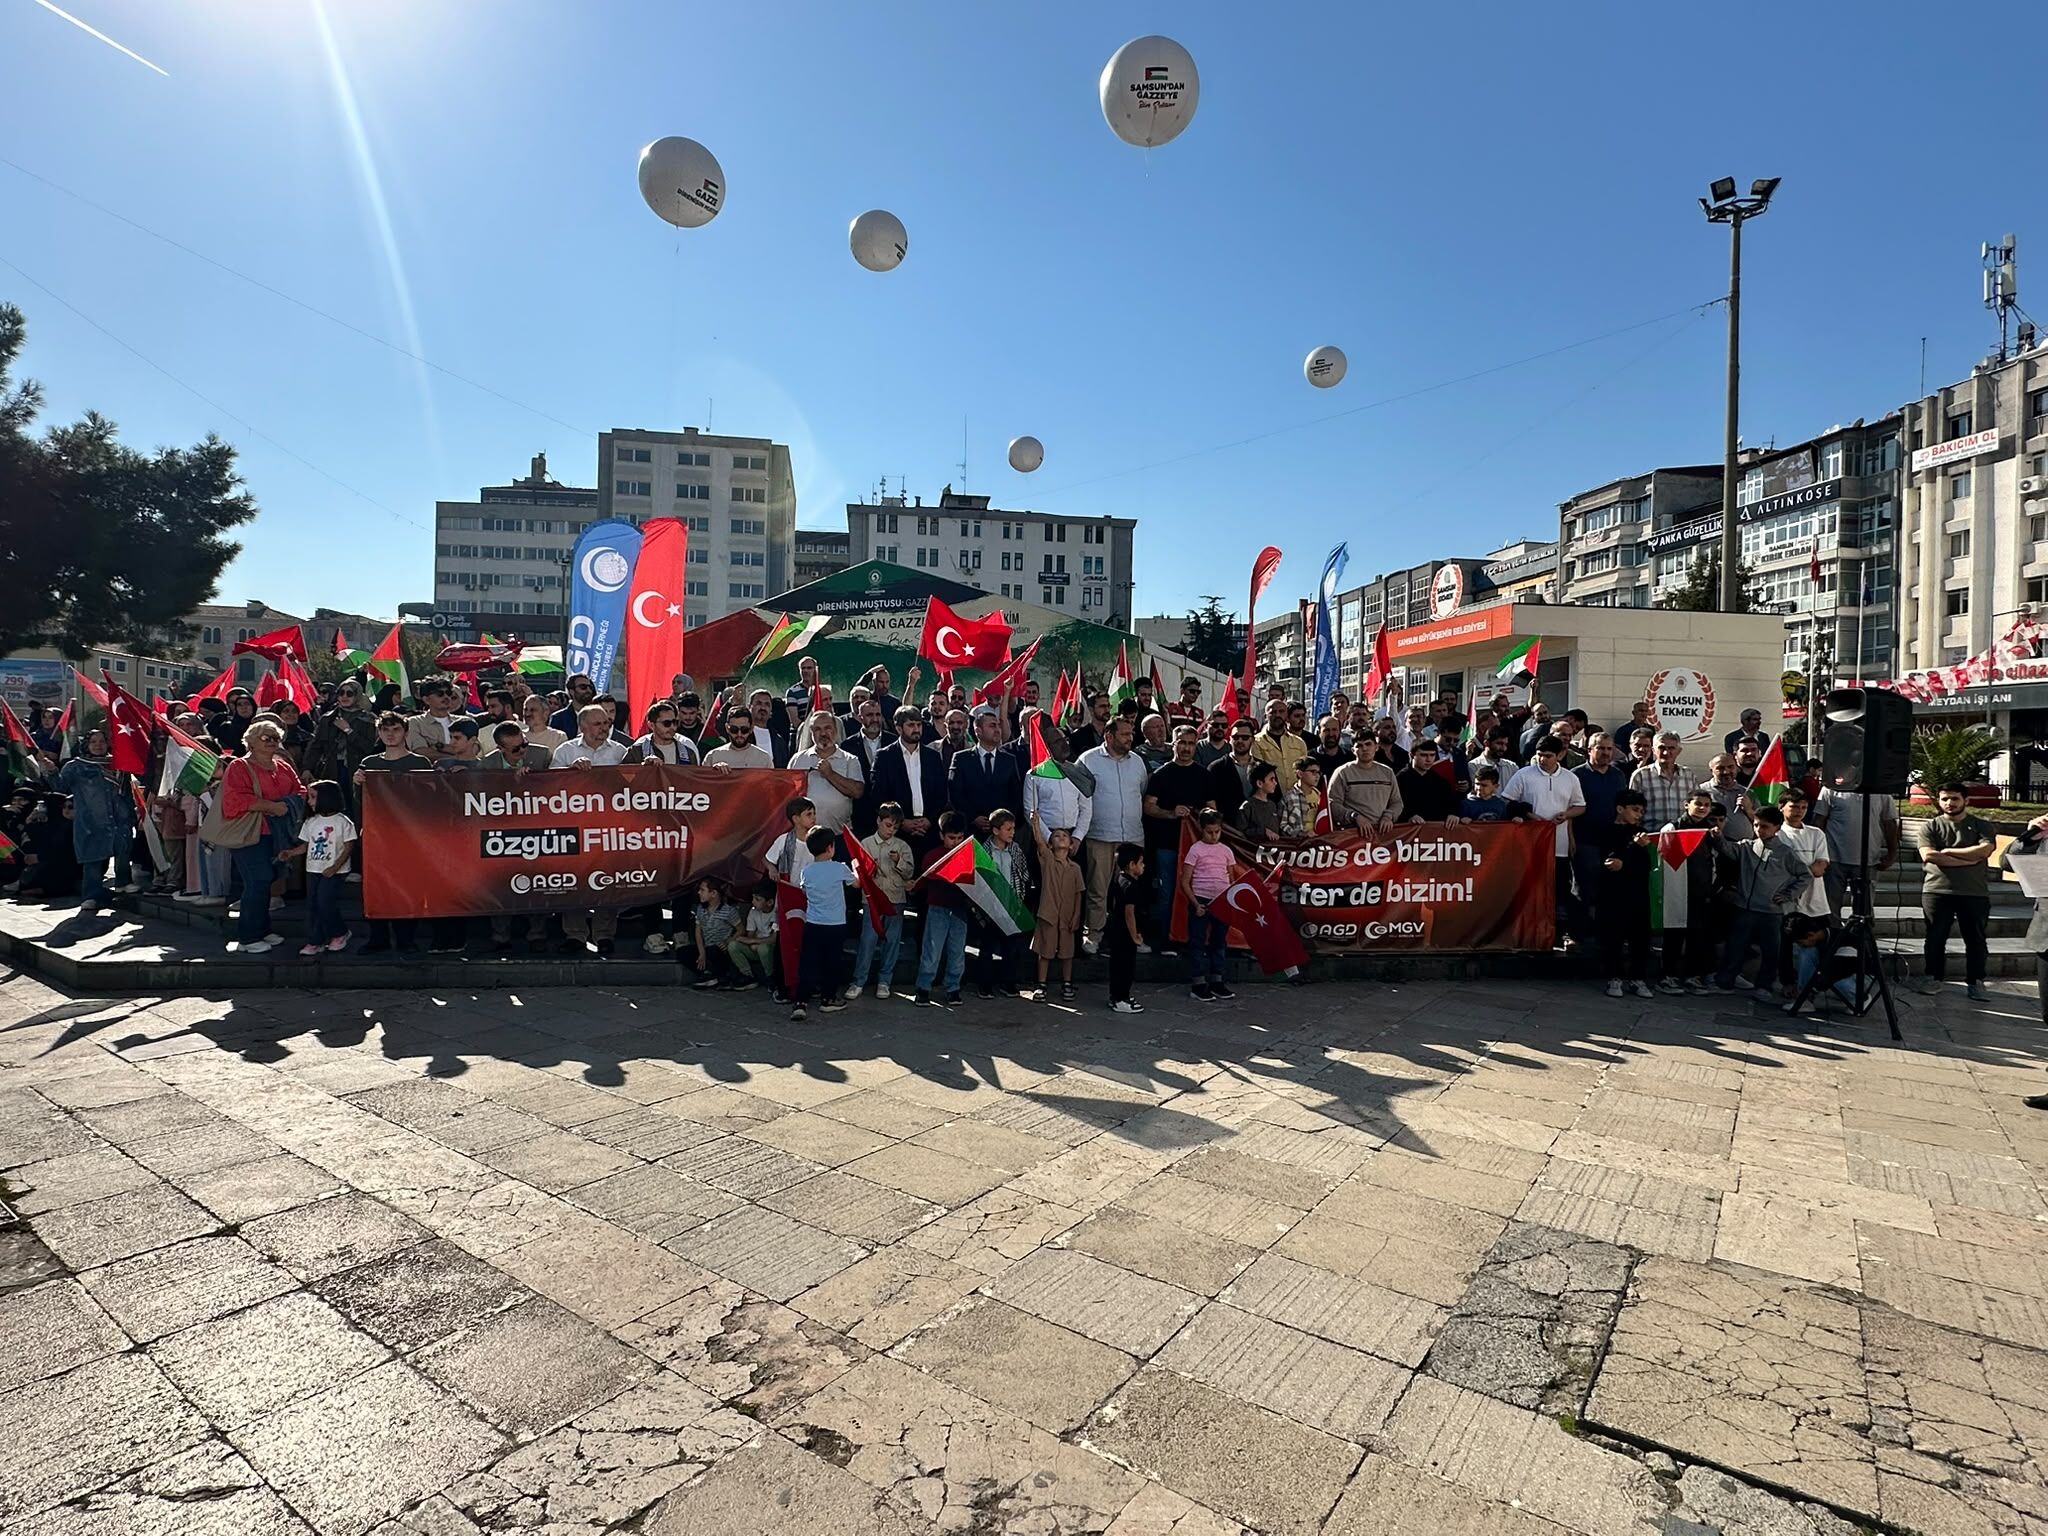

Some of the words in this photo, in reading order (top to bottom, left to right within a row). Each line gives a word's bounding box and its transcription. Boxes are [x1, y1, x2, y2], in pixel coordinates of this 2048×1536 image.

[1130, 82, 1184, 92] SAMSUN'DAN
[1136, 91, 1178, 100] GAZZE'YE
[1931, 435, 1978, 457] BAKICIM
[1982, 431, 1997, 443] OL
[1659, 531, 1682, 547] ANKA
[1683, 519, 1723, 539] GÜZELLİK
[816, 599, 858, 612] DİRENİŞİN
[859, 599, 905, 611] MUŞTUSU:
[1003, 610, 1020, 625] KİM
[566, 615, 595, 676] GD
[1397, 635, 1419, 648] SAMSUN
[1658, 695, 1703, 706] SAMSUN
[1662, 706, 1699, 718] EKMEK
[464, 790, 605, 817] Nehirden
[611, 786, 711, 812] denize
[485, 829, 577, 861] özgür
[583, 825, 689, 853] Filistin!
[1353, 843, 1391, 865] de
[1396, 837, 1482, 866] bizim,
[532, 873, 578, 888] AGD
[615, 869, 658, 883] MGV
[1349, 881, 1381, 906] de
[1387, 877, 1474, 903] bizim!
[1319, 923, 1358, 936] AGD
[1388, 921, 1425, 934] MGV
